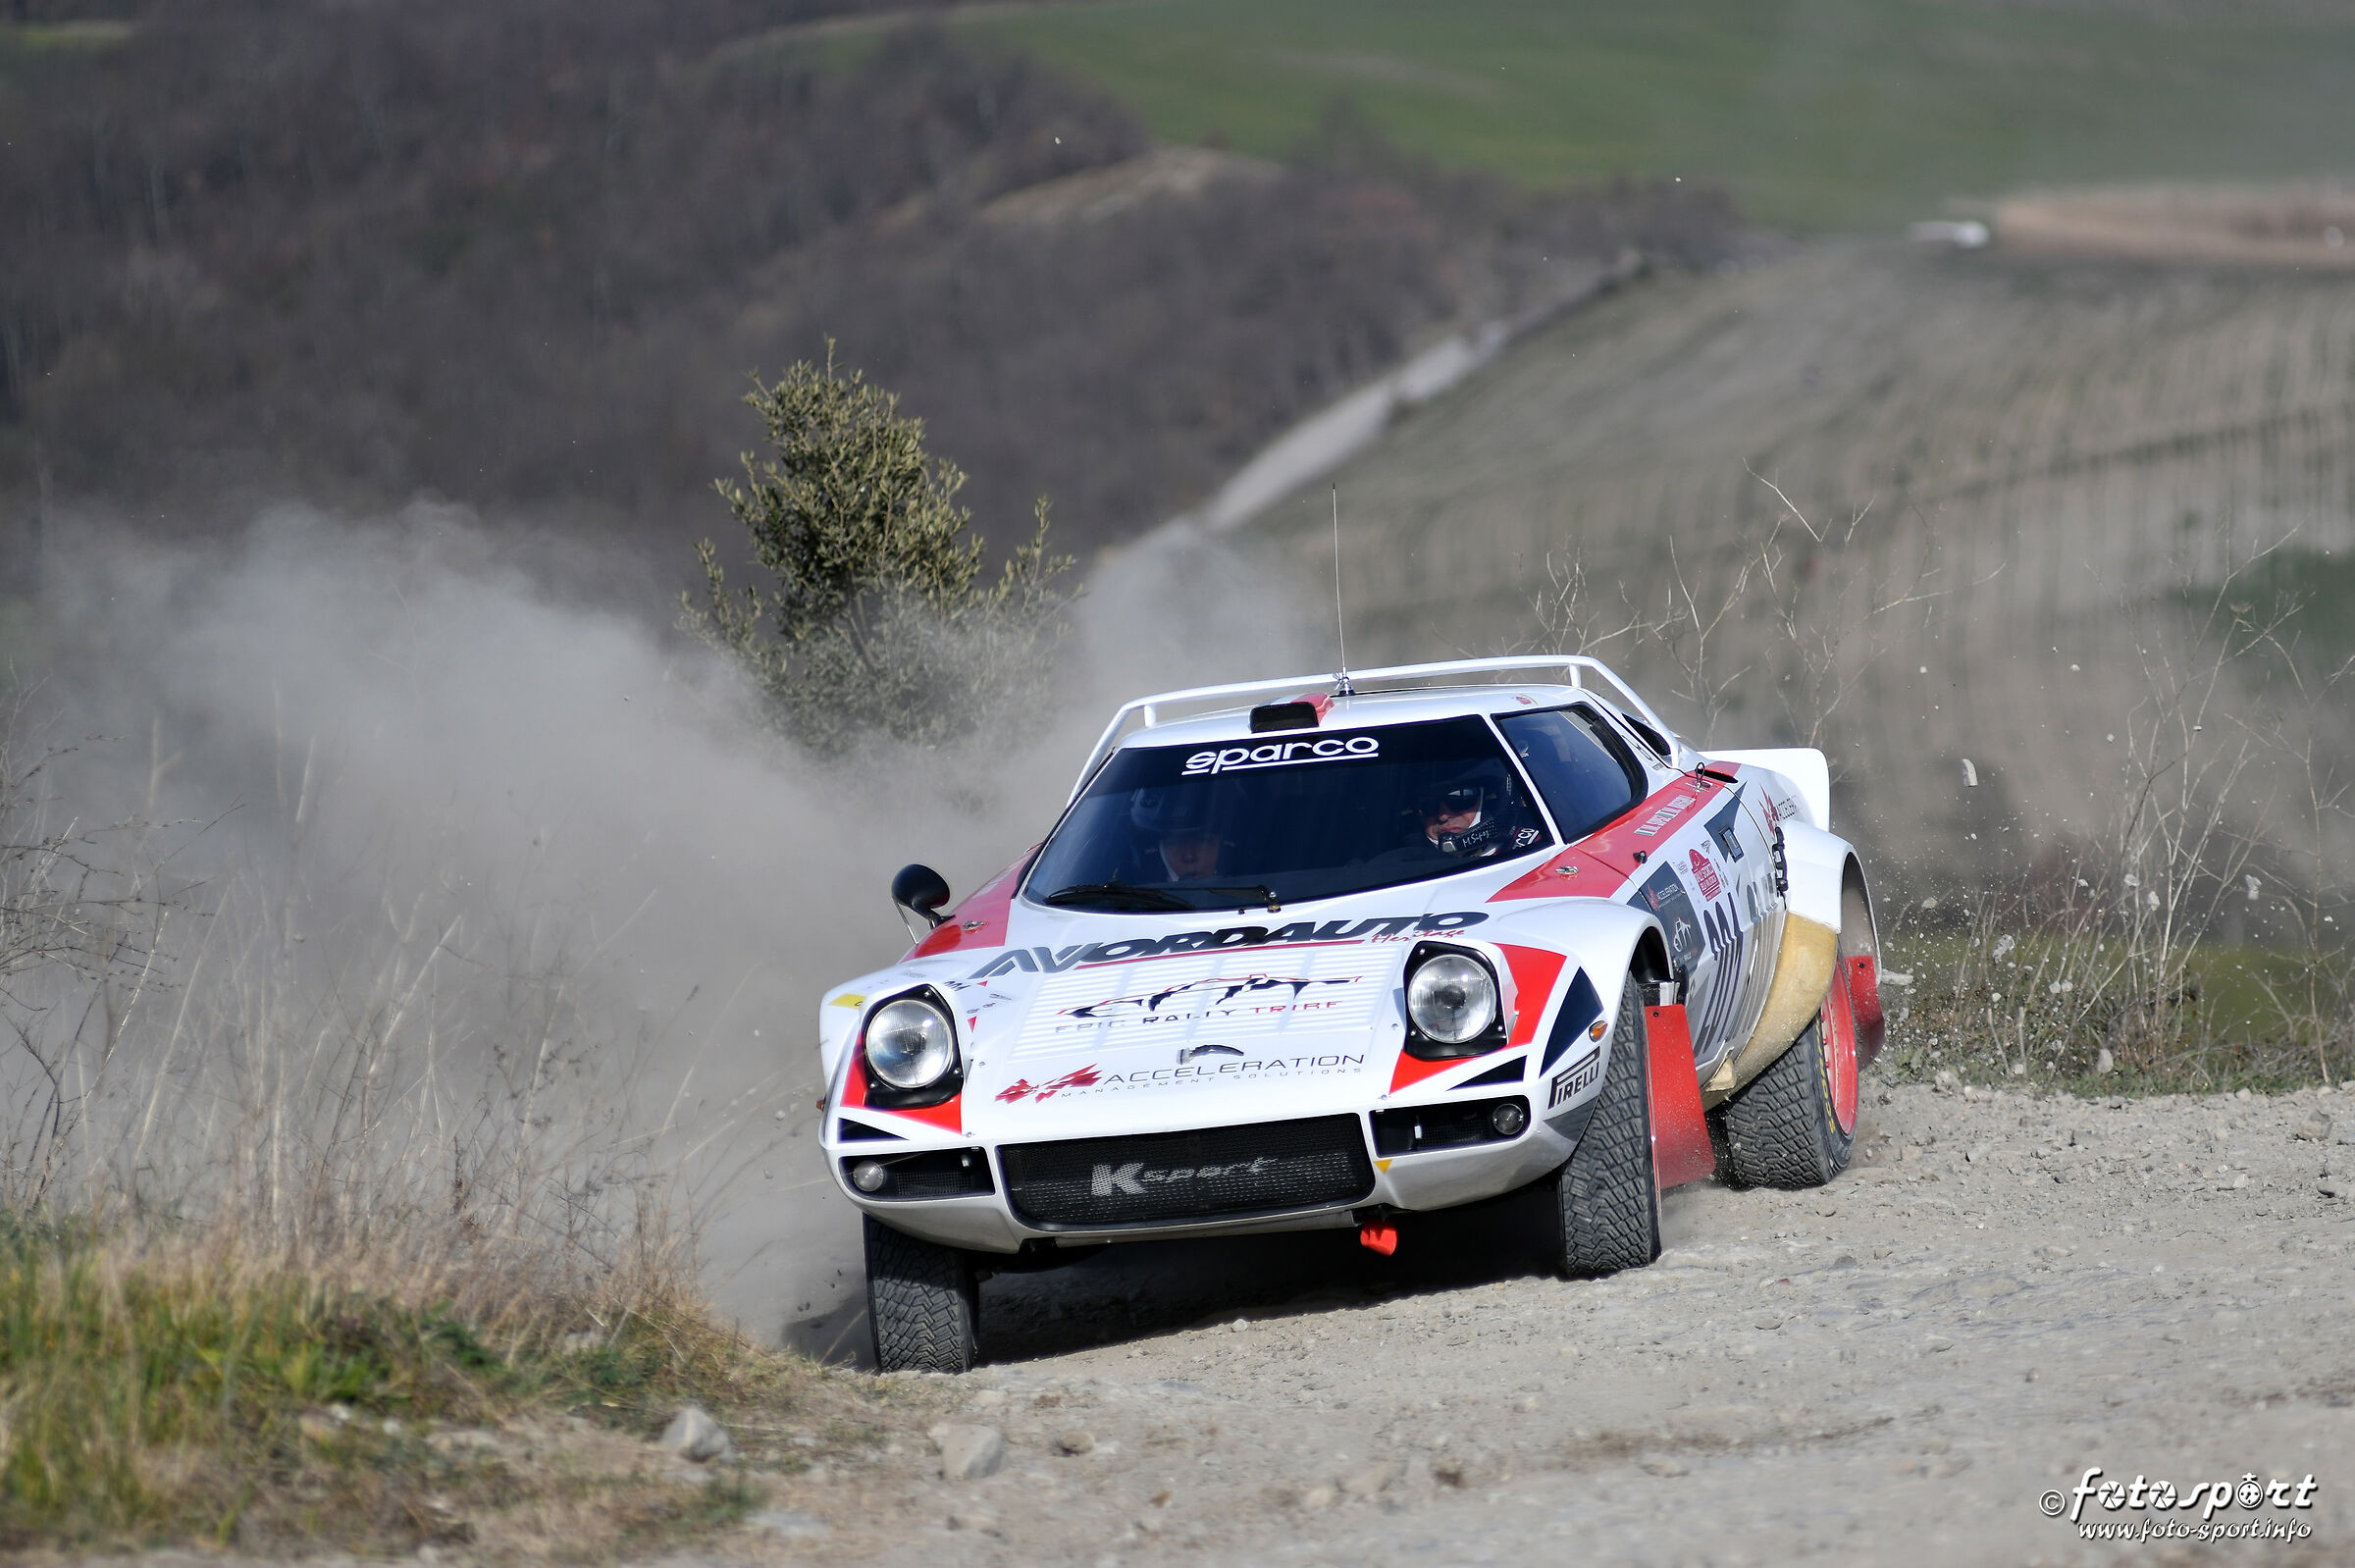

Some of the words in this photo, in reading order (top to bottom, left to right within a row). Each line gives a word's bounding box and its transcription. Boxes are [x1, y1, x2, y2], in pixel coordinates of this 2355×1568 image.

[1181, 736, 1380, 775] sparco
[1142, 1008, 1237, 1025] RALLY
[1061, 1076, 1217, 1099] MANAGEMENT
[1232, 1067, 1363, 1081] SOLUTIONS
[1103, 1054, 1366, 1085] ACCELERATION
[1546, 1047, 1600, 1110] PIRELLI
